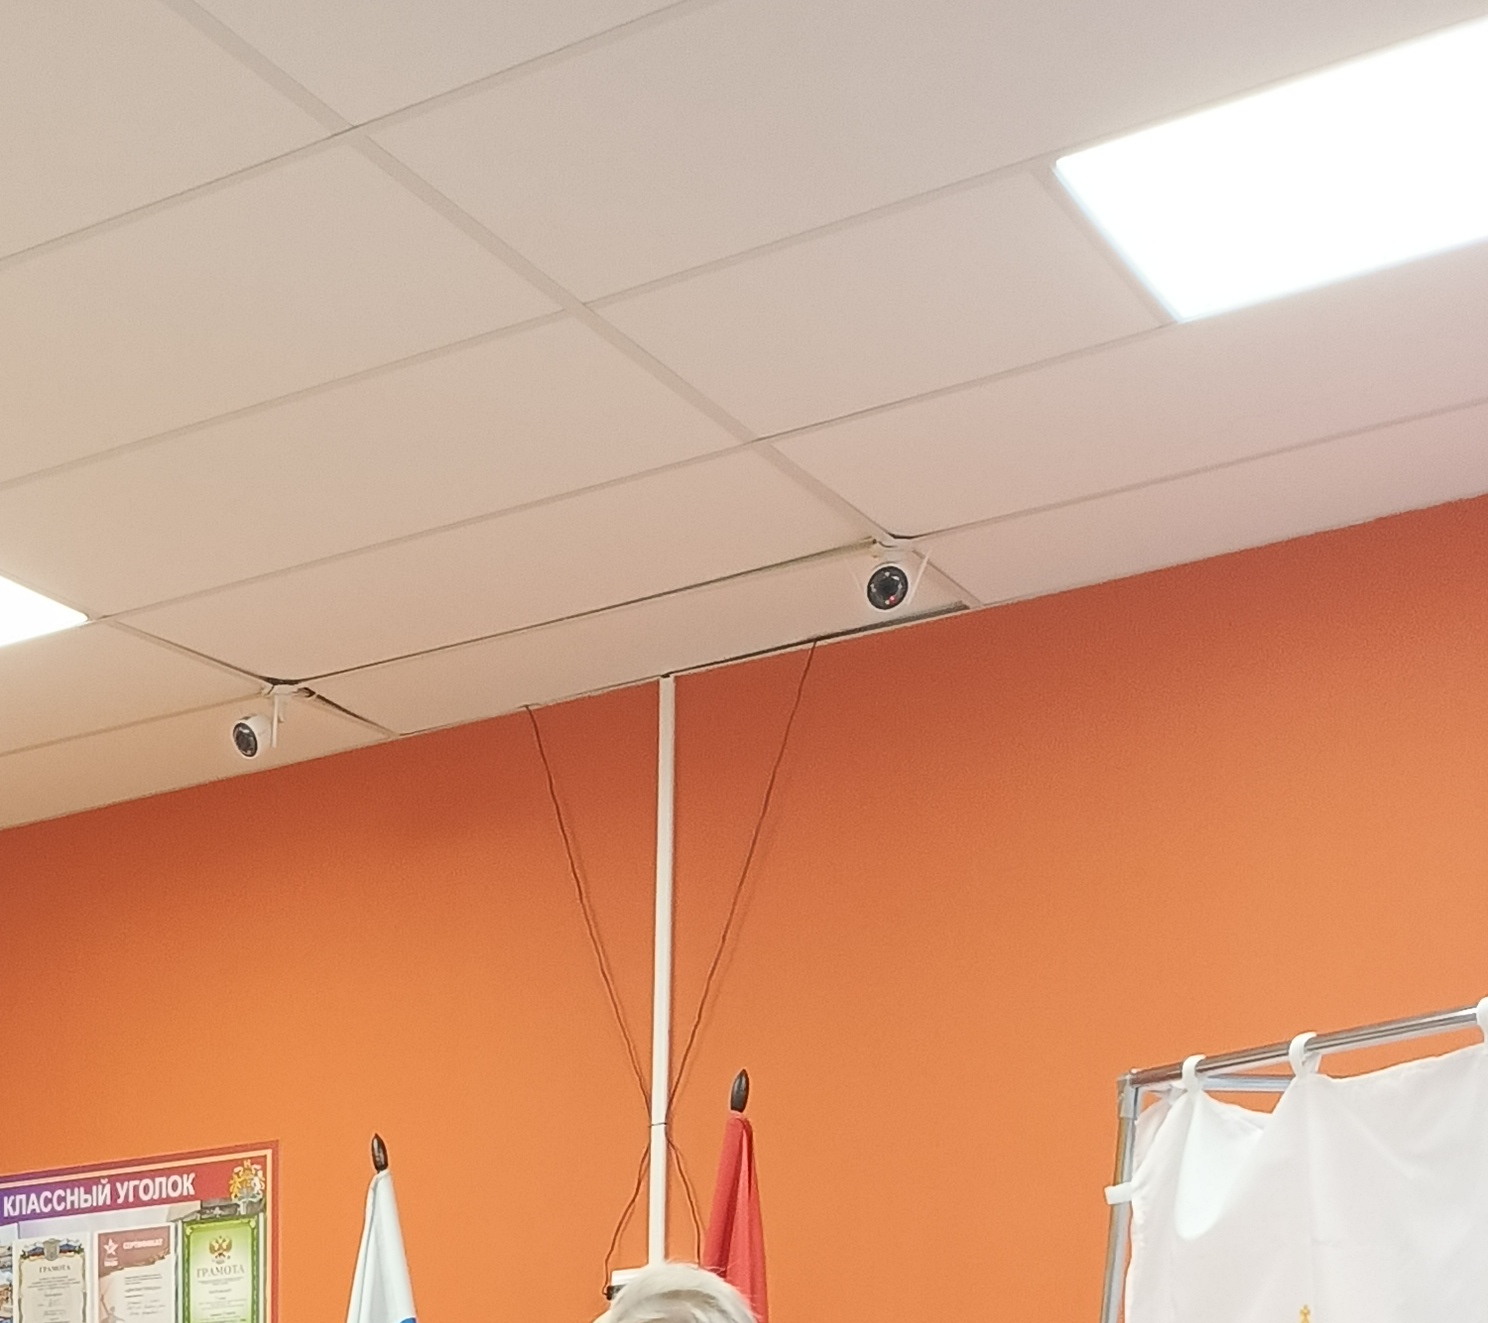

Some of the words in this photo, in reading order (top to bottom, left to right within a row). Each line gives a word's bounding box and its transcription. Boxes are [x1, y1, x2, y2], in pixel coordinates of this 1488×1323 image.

[3, 1177, 111, 1217] КЛАССНЫЙ
[116, 1172, 196, 1204] УГОЛОК
[39, 1264, 71, 1273] ГРАМОТА
[196, 1264, 245, 1278] ГРАМОТА
